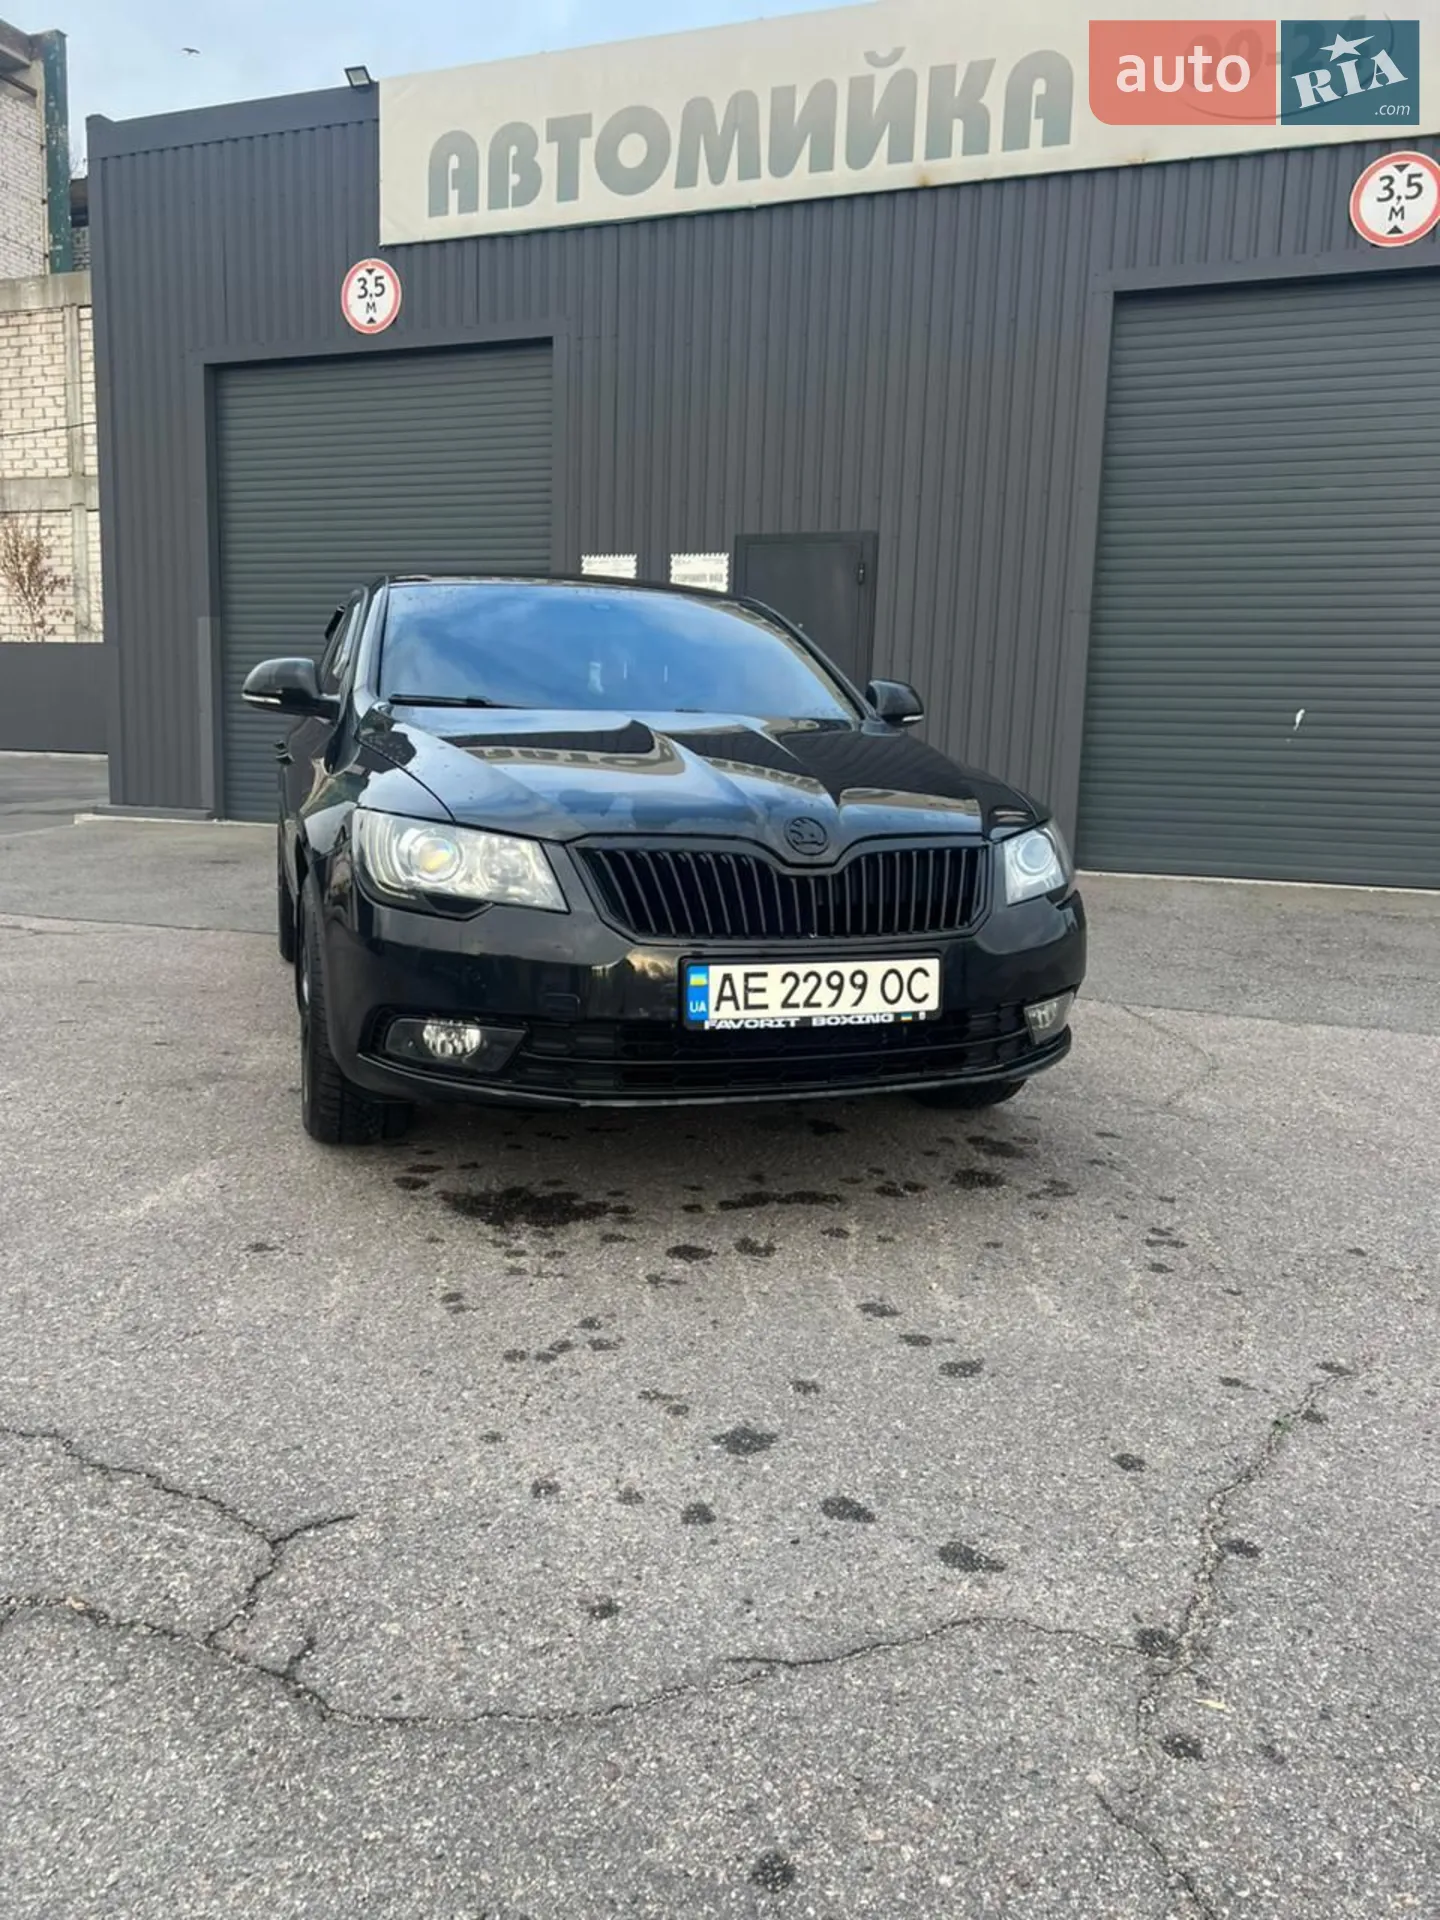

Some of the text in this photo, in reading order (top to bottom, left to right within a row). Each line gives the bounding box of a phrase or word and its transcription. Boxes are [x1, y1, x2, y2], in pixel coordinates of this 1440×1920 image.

[428, 46, 1074, 218] АВТОМИЙКА
[1376, 173, 1423, 204] 3,5
[357, 276, 385, 300] 3,5
[714, 972, 768, 1012] AE
[780, 969, 868, 1009] 2299
[689, 1000, 707, 1013] UA
[704, 1013, 895, 1030] FAVORIT BOXING
